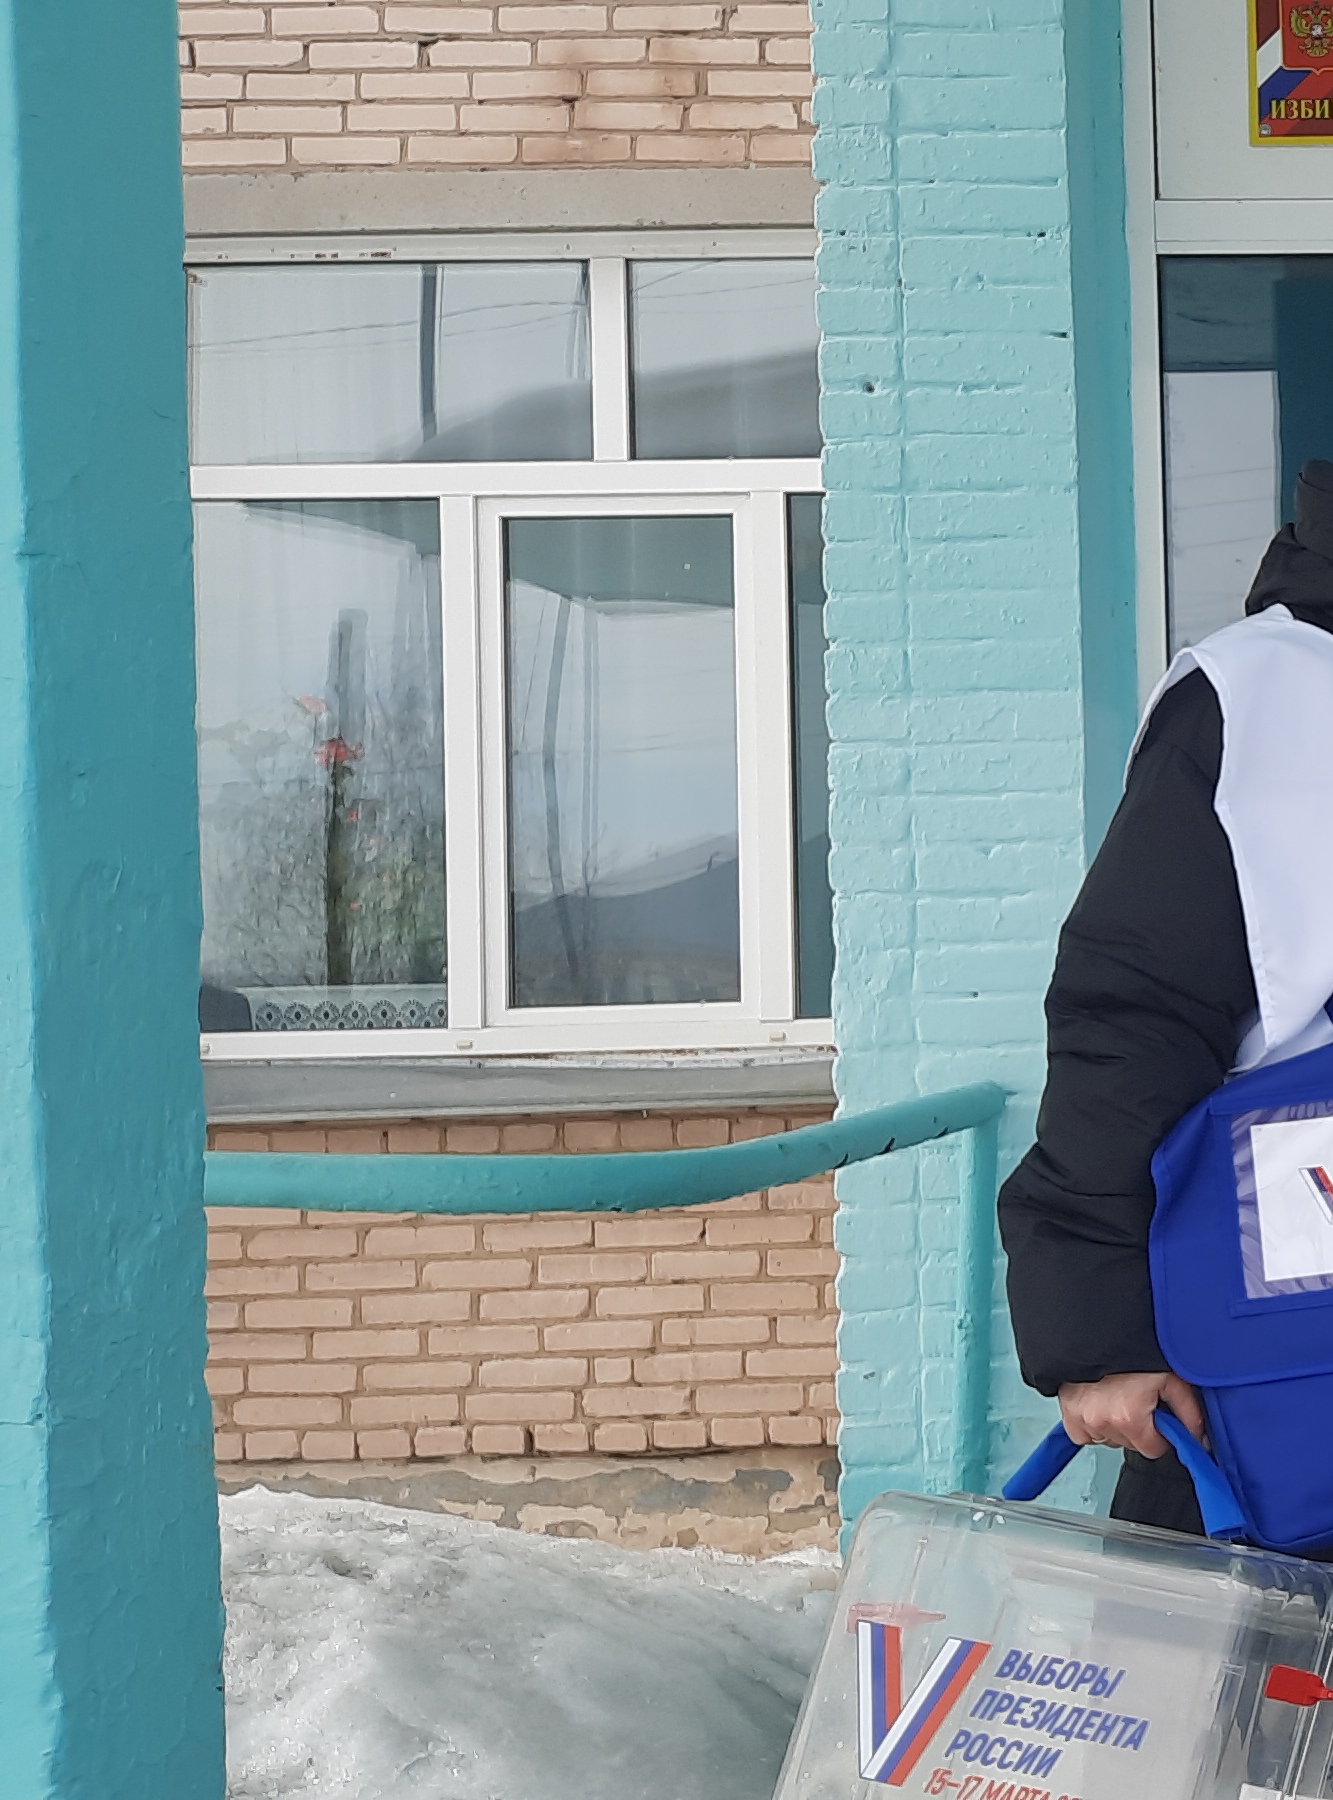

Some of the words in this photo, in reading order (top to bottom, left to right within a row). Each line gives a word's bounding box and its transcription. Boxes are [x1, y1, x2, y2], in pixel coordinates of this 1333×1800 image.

[994, 1648, 1127, 1699] ВЫБОРЫ
[968, 1688, 1150, 1751] ПРЕЗИДЕНТА
[944, 1728, 1064, 1779] РОССИИ
